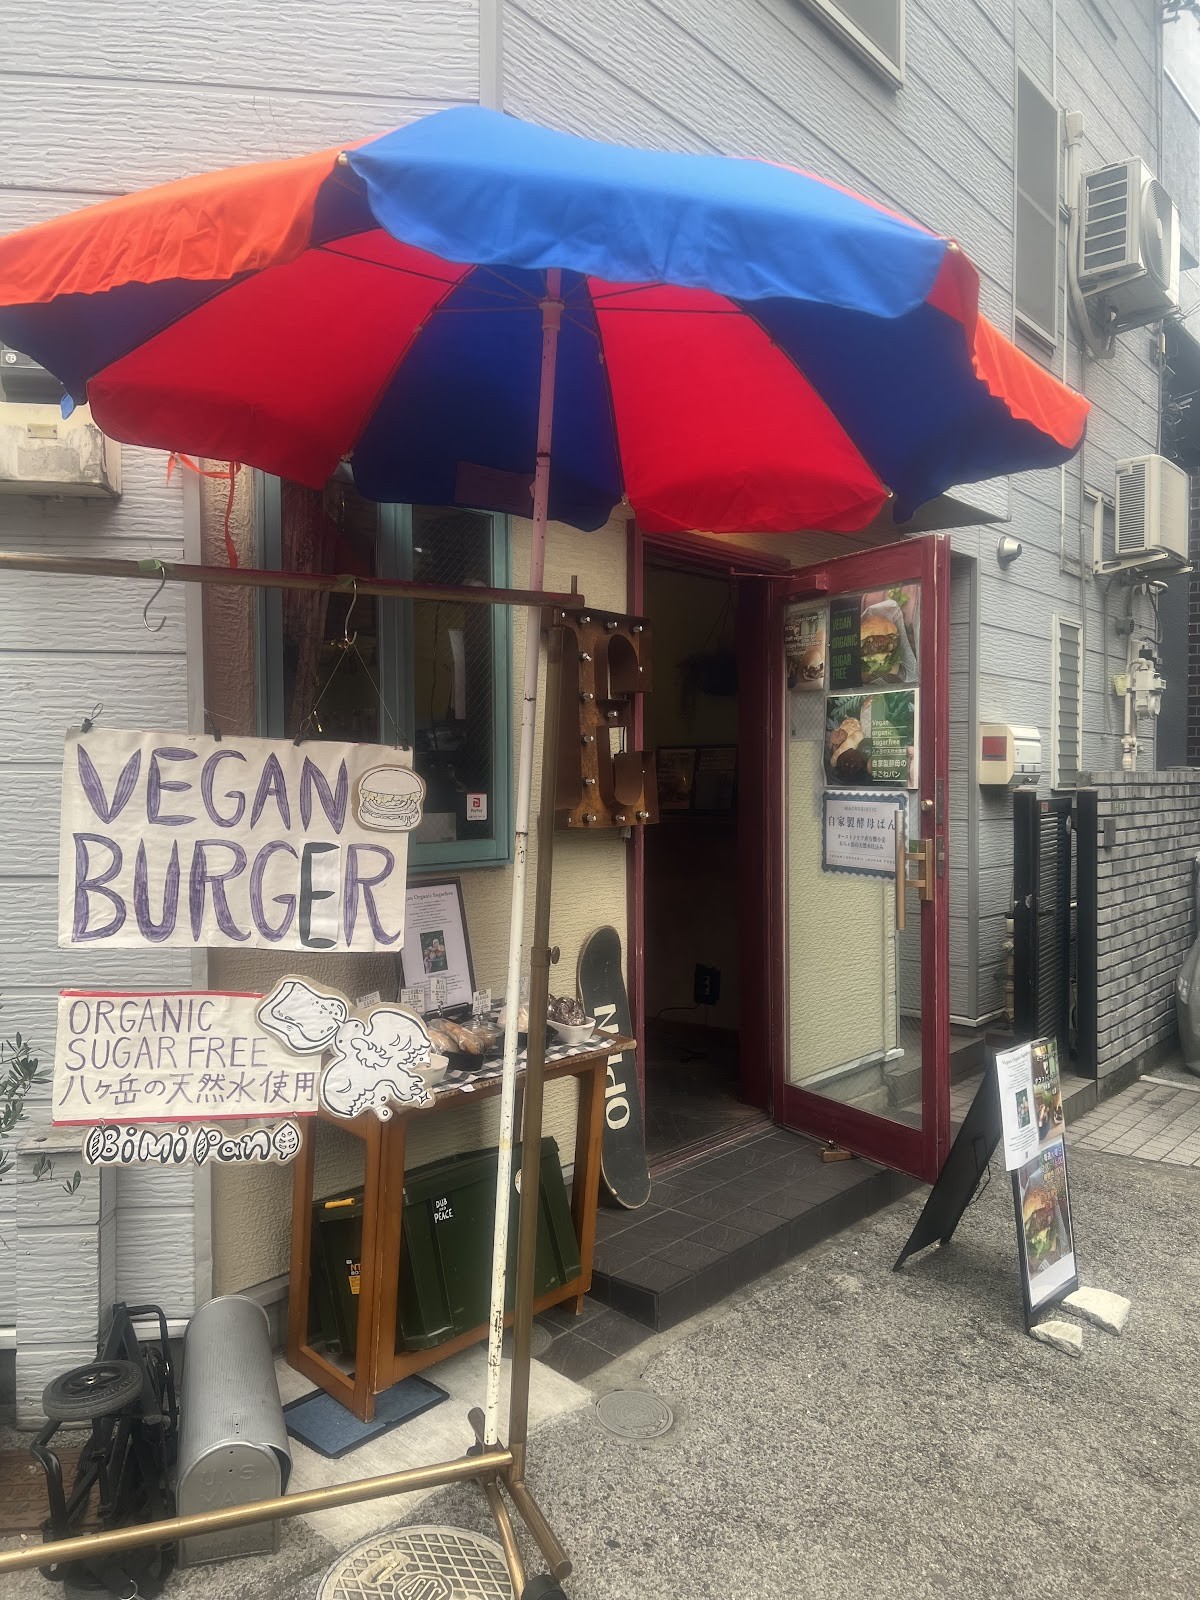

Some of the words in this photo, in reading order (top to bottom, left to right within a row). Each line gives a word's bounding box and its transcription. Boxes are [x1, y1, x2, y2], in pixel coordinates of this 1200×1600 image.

[833, 615, 852, 630] VEGAN
[832, 633, 858, 649] ORGANIC
[833, 653, 852, 668] SUGAR
[833, 667, 847, 680] FREE
[872, 729, 892, 737] organic
[76, 742, 349, 835] VEGAN
[71, 832, 402, 949] BURGER
[68, 998, 216, 1035] ORGANIC
[64, 1035, 178, 1072] SUGAR
[187, 1036, 269, 1069] FREE
[435, 1197, 448, 1209] DUB
[433, 1208, 454, 1224] PEACE
